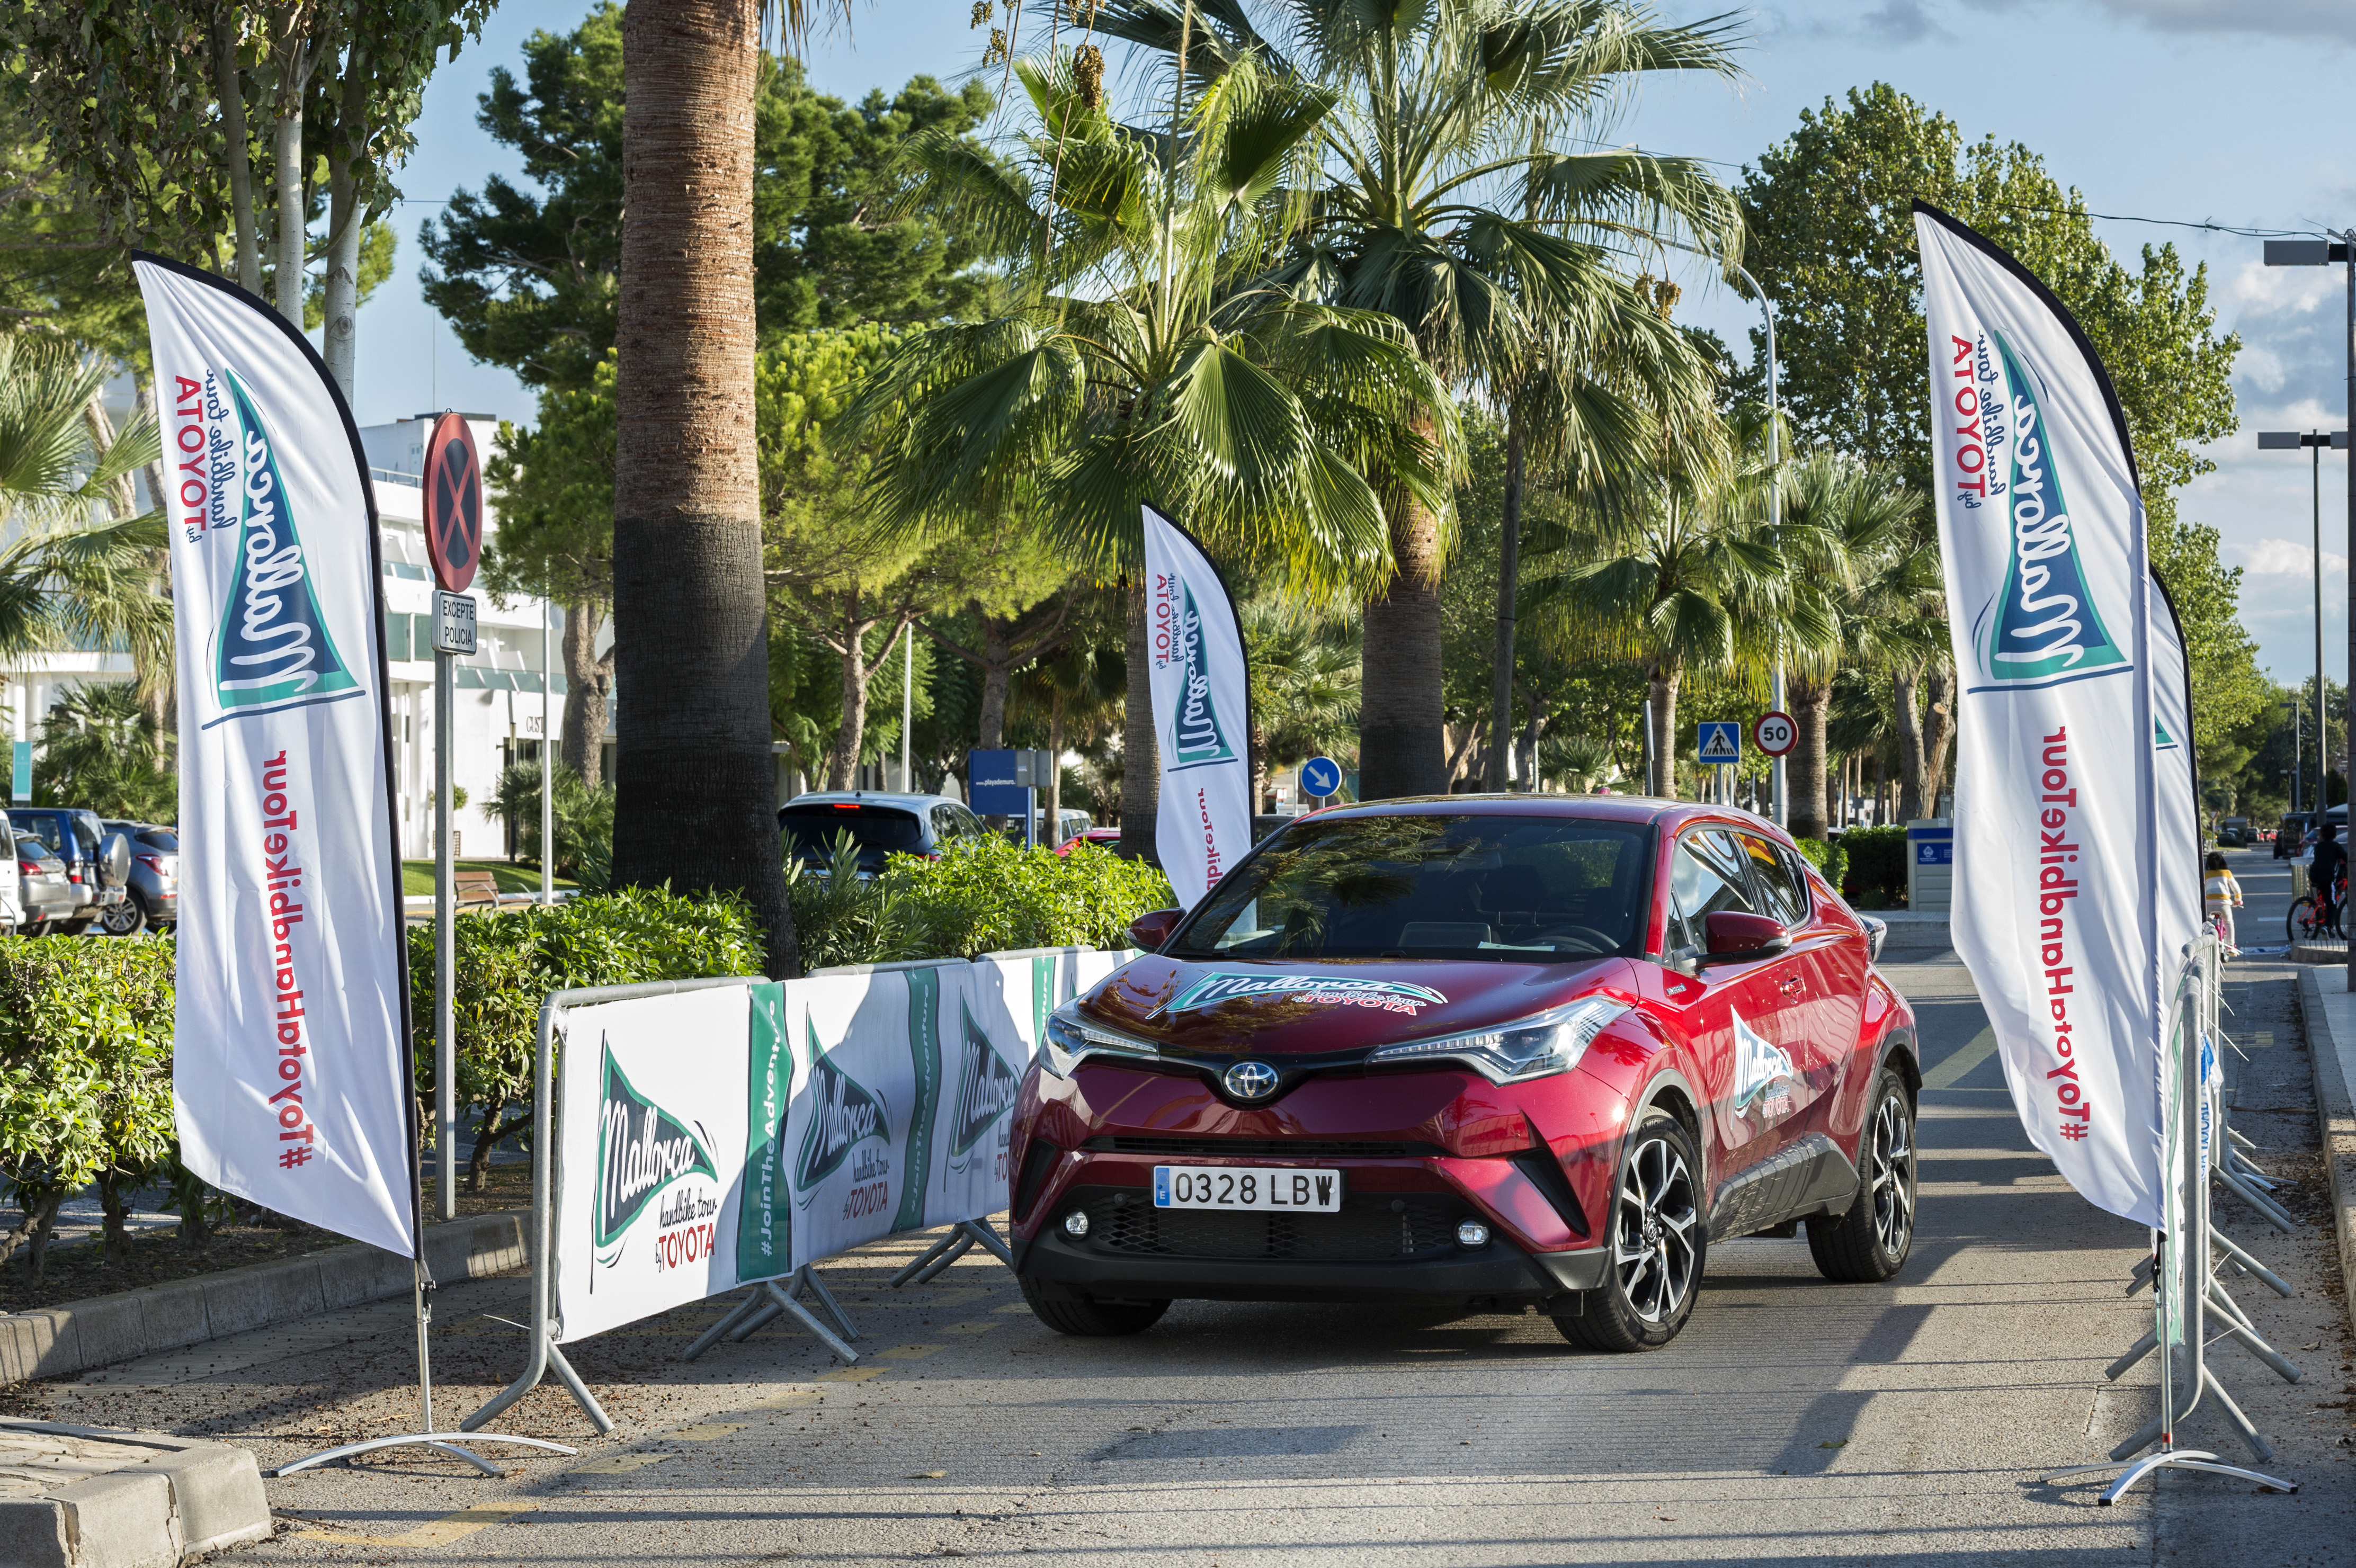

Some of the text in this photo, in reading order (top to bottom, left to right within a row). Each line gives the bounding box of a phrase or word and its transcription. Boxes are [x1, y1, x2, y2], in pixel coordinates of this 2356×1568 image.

[443, 601, 474, 621] EXCEPTE
[444, 625, 473, 646] POLICIA
[1763, 726, 1787, 741] 50
[1184, 976, 1394, 1007] Mallorca
[1304, 996, 1417, 1016] TOYOTA
[1306, 990, 1426, 1007] handbike tour
[1739, 1037, 1783, 1104] Mallorca
[911, 984, 931, 1213] #JoinTheAdventure
[954, 1040, 1016, 1153] Mallorca
[1764, 1095, 1789, 1118] TOYOTA
[760, 1000, 781, 1257] #JoinTheAdventure
[811, 1063, 877, 1168] Mallorca
[1646, 1119, 1673, 1130] MICHELIN
[602, 1098, 695, 1242] Mallorca
[852, 1148, 889, 1184] handbike tour
[846, 1180, 888, 1220] TOYOTA
[1160, 1191, 1165, 1199] E
[1175, 1173, 1333, 1206] 0328 LBW
[659, 1187, 717, 1229] handbike tour
[655, 1223, 715, 1273] by TOYOTA
